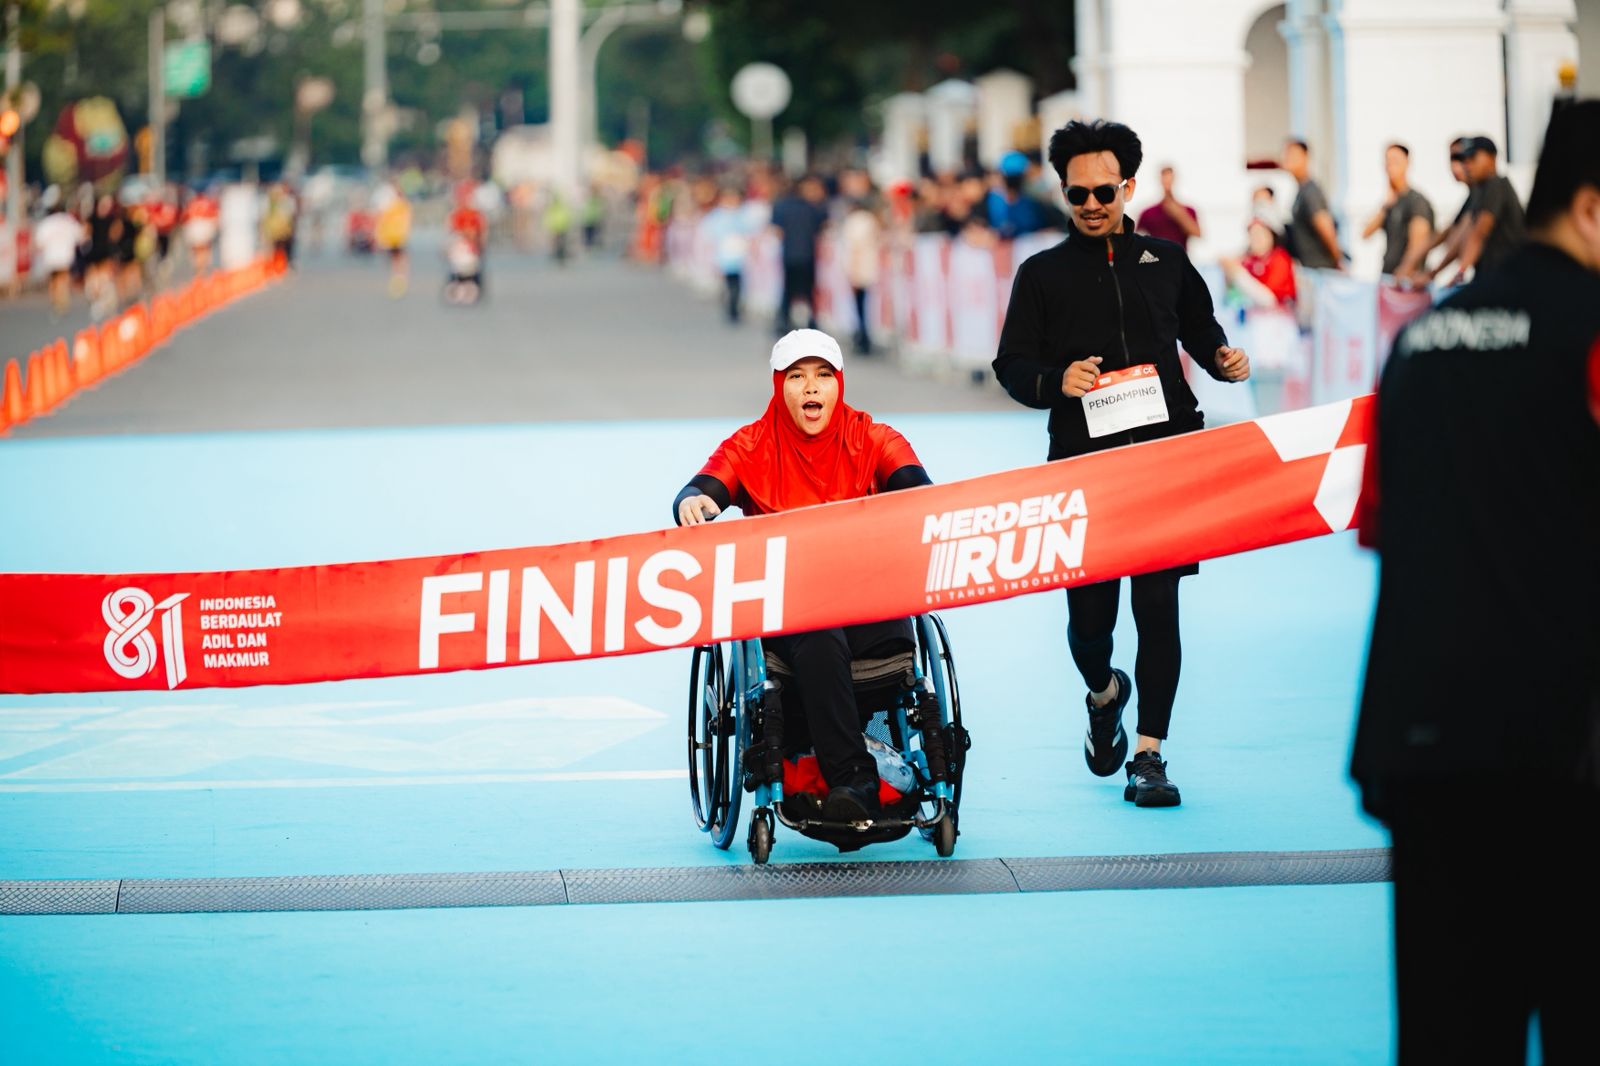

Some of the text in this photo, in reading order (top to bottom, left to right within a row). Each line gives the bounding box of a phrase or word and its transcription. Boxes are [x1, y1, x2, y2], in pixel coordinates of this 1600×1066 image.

[1088, 386, 1157, 411] PENDAMPING
[921, 488, 1088, 544] MERDEKA
[951, 517, 1088, 589] RUN
[949, 586, 996, 600] TAHUN
[1004, 570, 1086, 591] INDONESIA
[200, 595, 276, 611] INDONESIA
[419, 536, 787, 669] FINISH
[200, 612, 282, 630] BERDAULAT
[102, 587, 191, 690] 81
[202, 632, 267, 649] ADIL DAN
[204, 651, 269, 668] MAKMUR
